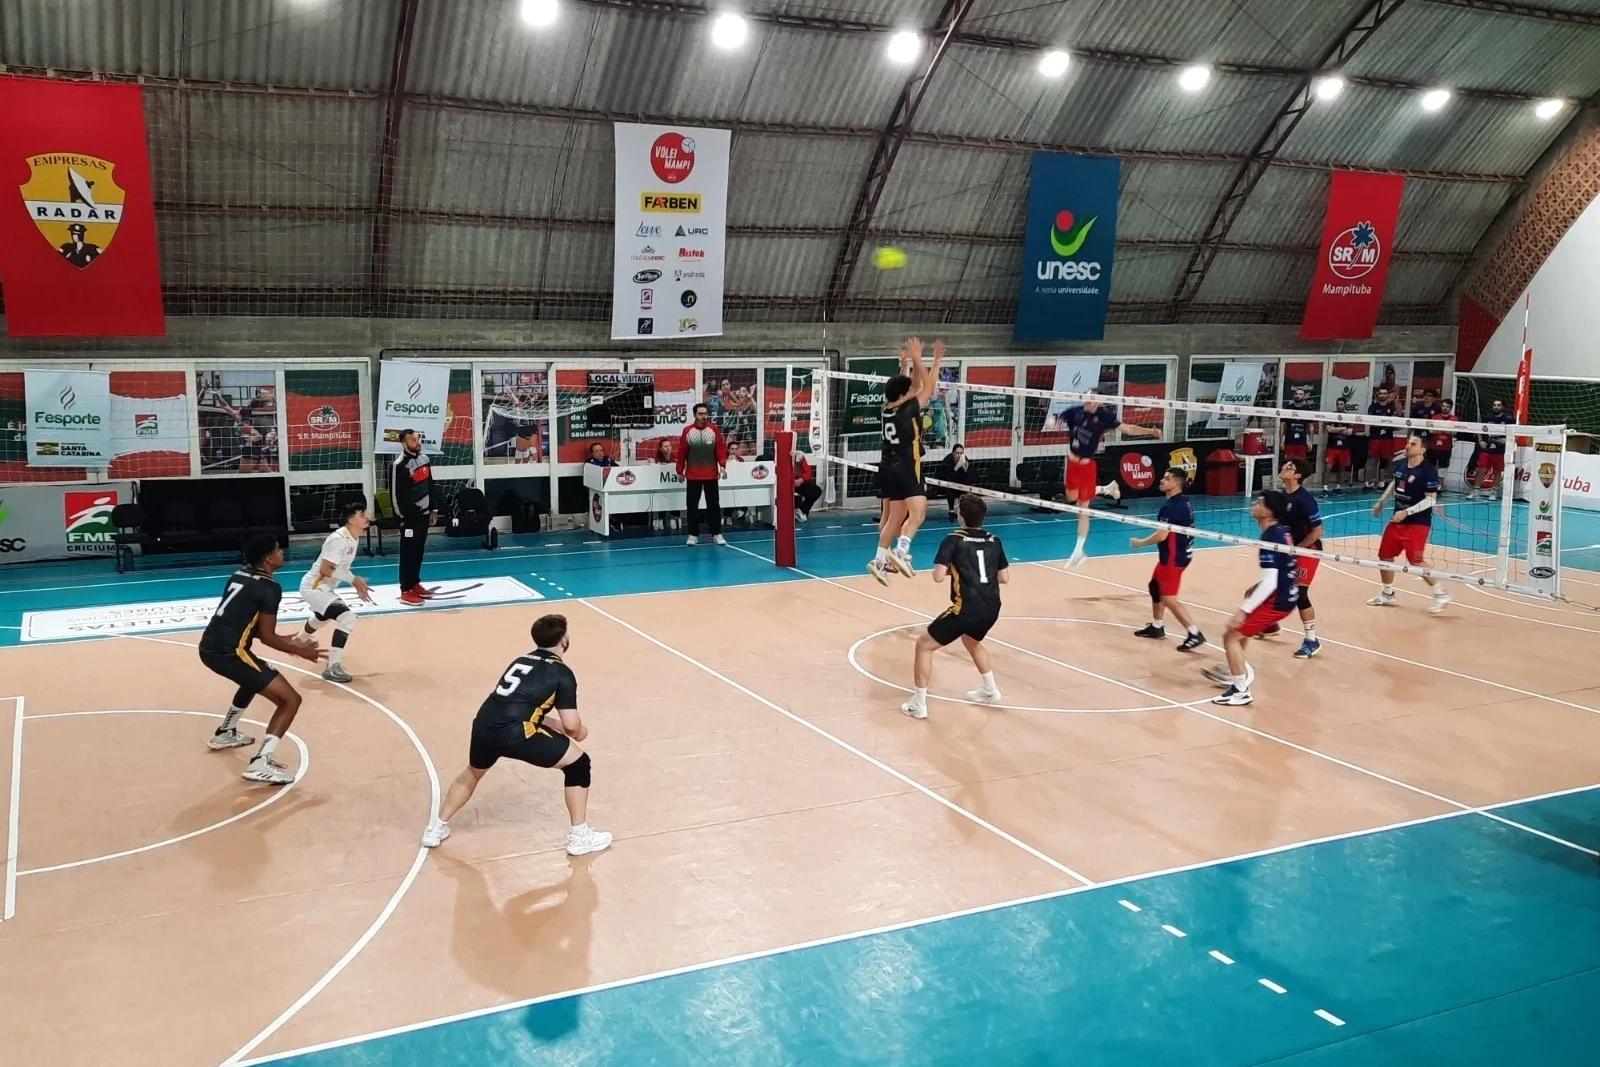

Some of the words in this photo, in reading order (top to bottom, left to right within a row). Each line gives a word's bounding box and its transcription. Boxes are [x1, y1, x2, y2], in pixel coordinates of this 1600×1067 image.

[33, 155, 107, 171] EMPRESAS
[664, 158, 690, 169] MAMPI
[644, 196, 698, 209] FARBEN
[36, 205, 117, 221] RADAR
[687, 227, 708, 235] URC
[1037, 261, 1101, 281] unesc
[1058, 286, 1099, 295] universidade
[1322, 283, 1372, 296] Mampituba
[589, 374, 619, 383] LOCAL
[621, 374, 654, 383] VISITANTE
[386, 400, 440, 416] Fesporte
[35, 411, 101, 427] Fesporte
[66, 544, 117, 553] CRICIUM
[976, 549, 989, 584] 1
[215, 582, 243, 617] 7
[496, 662, 534, 697] 5
